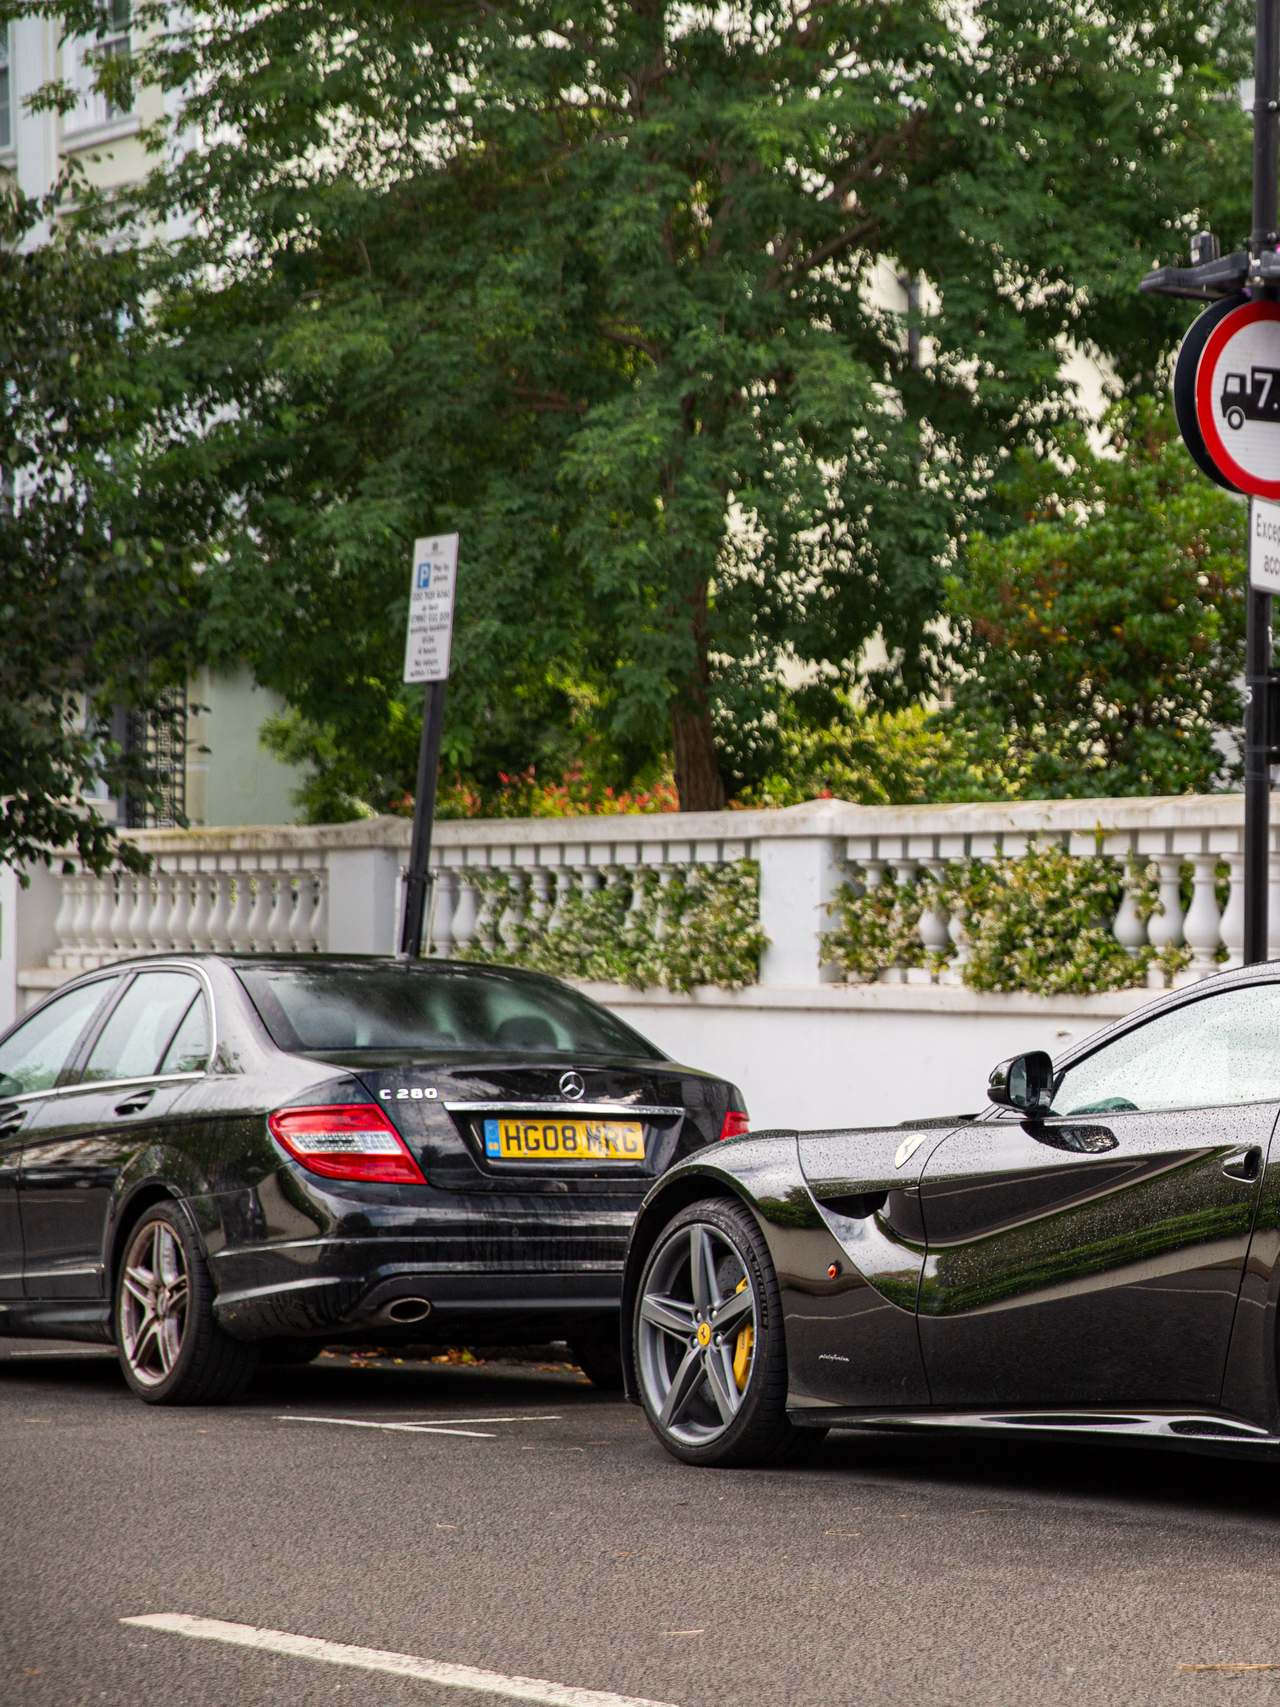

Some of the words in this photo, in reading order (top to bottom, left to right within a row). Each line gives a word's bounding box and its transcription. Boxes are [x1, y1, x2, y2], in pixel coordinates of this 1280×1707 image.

[379, 1088, 392, 1100] C
[396, 1087, 438, 1100] 280
[504, 1124, 578, 1151] HG08
[751, 1260, 768, 1326] MICHELIN
